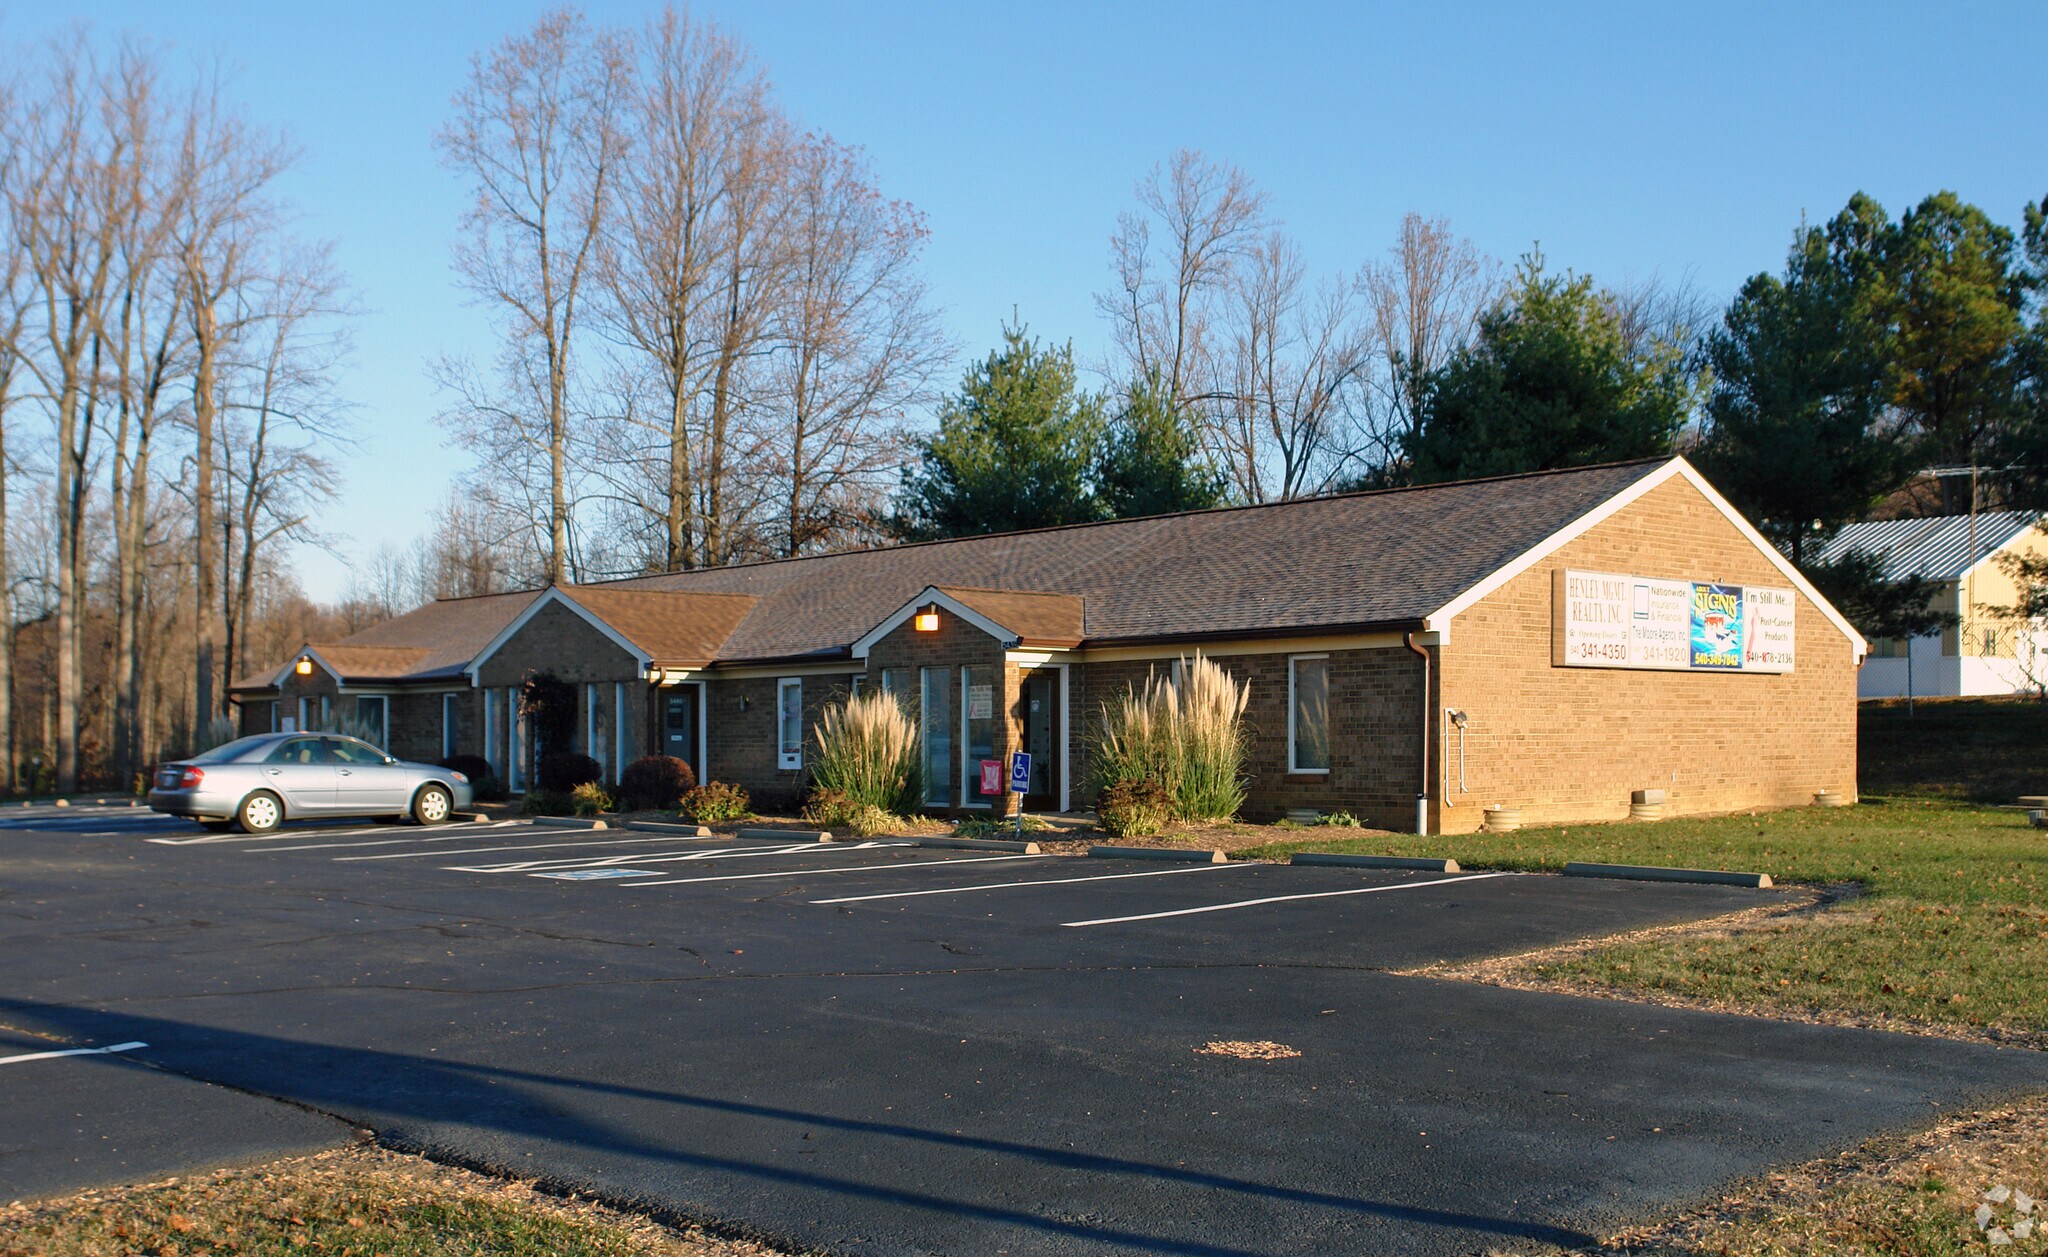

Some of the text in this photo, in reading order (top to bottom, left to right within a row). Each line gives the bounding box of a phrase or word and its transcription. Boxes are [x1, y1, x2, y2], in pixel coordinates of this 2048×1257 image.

[1569, 578, 1627, 601] HENLEY MGMT.
[1651, 586, 1686, 598] Nationwide
[1745, 590, 1758, 603] I'm
[1759, 591, 1773, 604] Still
[1651, 600, 1680, 610] Insurance
[1694, 592, 1737, 620] SIGNS
[1608, 604, 1624, 624] INC.
[1760, 616, 1793, 627] Post-Cancer
[1632, 625, 1641, 639] The
[1642, 626, 1658, 640] Moore
[1764, 631, 1788, 641] Products
[1581, 642, 1627, 660] 341-4350
[1643, 646, 1686, 662] 341-1920
[1012, 780, 1028, 788] PARKING
